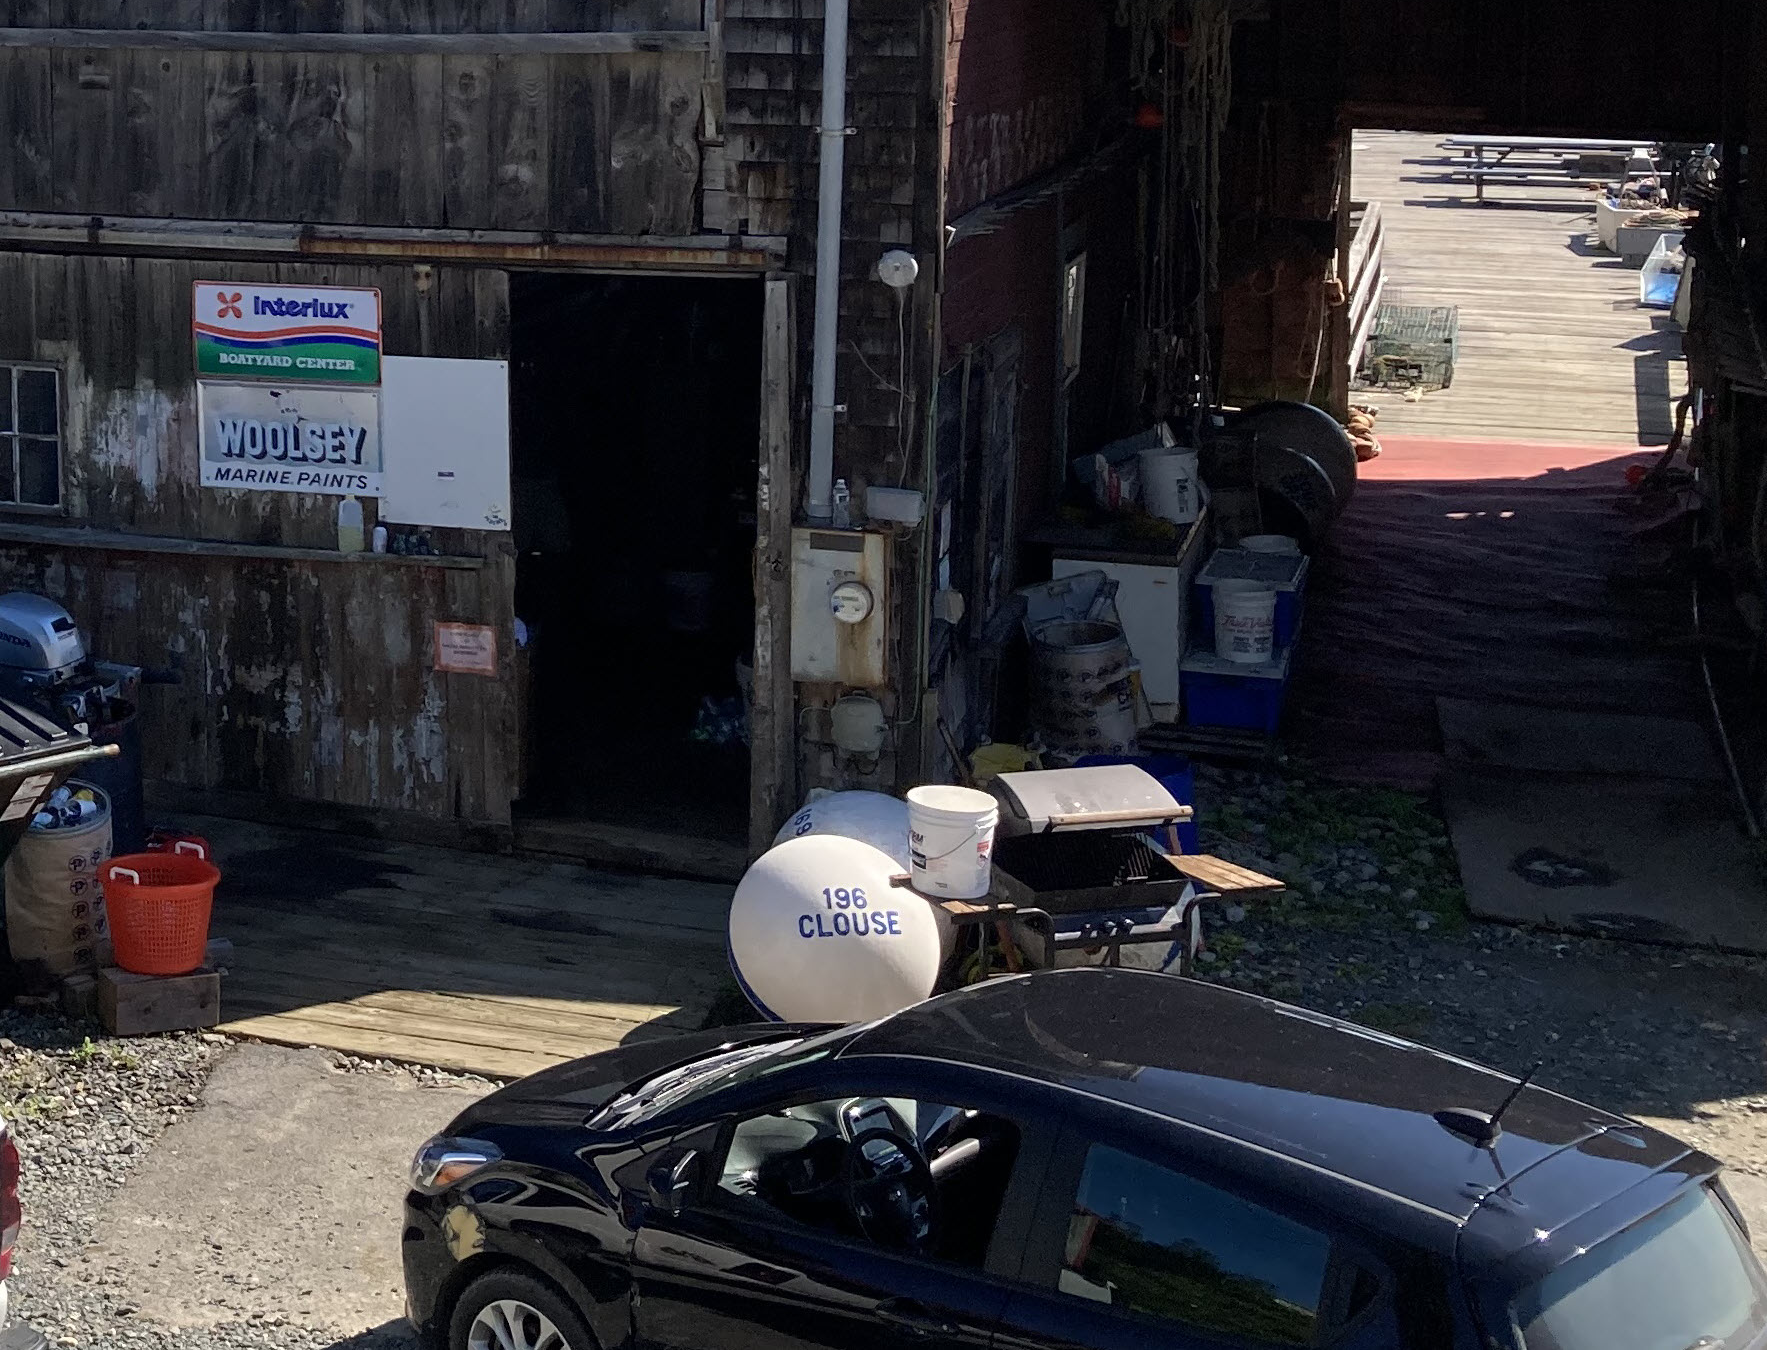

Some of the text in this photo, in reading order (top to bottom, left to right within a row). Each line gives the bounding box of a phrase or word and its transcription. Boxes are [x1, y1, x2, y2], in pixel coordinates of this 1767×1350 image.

[253, 295, 349, 319] Interlux
[219, 352, 356, 371] BOATYARD CENTER
[215, 417, 367, 465] WOOLSEY
[214, 467, 368, 490] MARINE PAINTS
[822, 887, 867, 909] 196
[798, 911, 902, 938] CLOUSE
